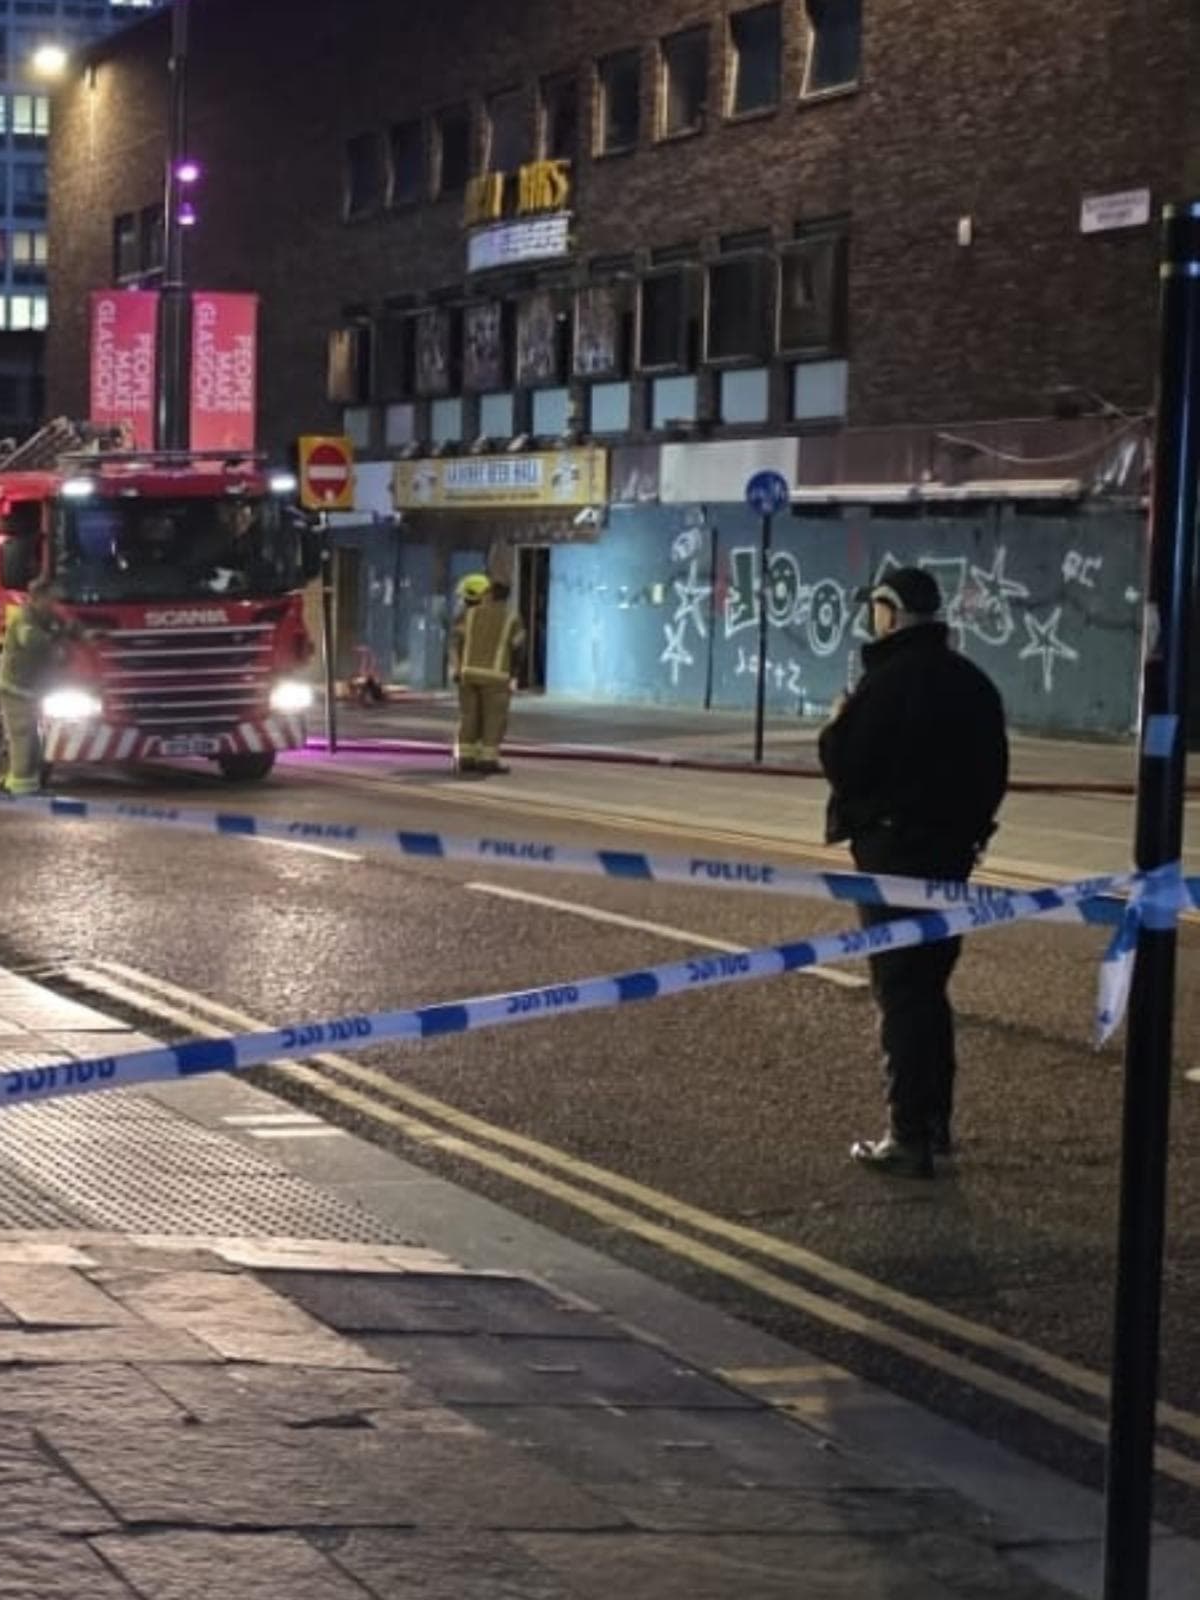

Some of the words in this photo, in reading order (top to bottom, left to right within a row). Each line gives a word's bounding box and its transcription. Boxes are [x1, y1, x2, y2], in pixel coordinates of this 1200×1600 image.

[96, 299, 116, 411] GLASGOW
[115, 350, 134, 412] MAKE
[133, 332, 152, 413] PEOPLE
[196, 301, 217, 412] GLASGOW
[216, 350, 235, 413] MAKE
[234, 334, 252, 413] PEOPLE
[144, 608, 229, 627] SCANIA
[479, 839, 555, 862] POLICE
[688, 859, 777, 885] POLICE
[281, 1016, 372, 1048] POLICE
[5, 1057, 116, 1095] POLICE
